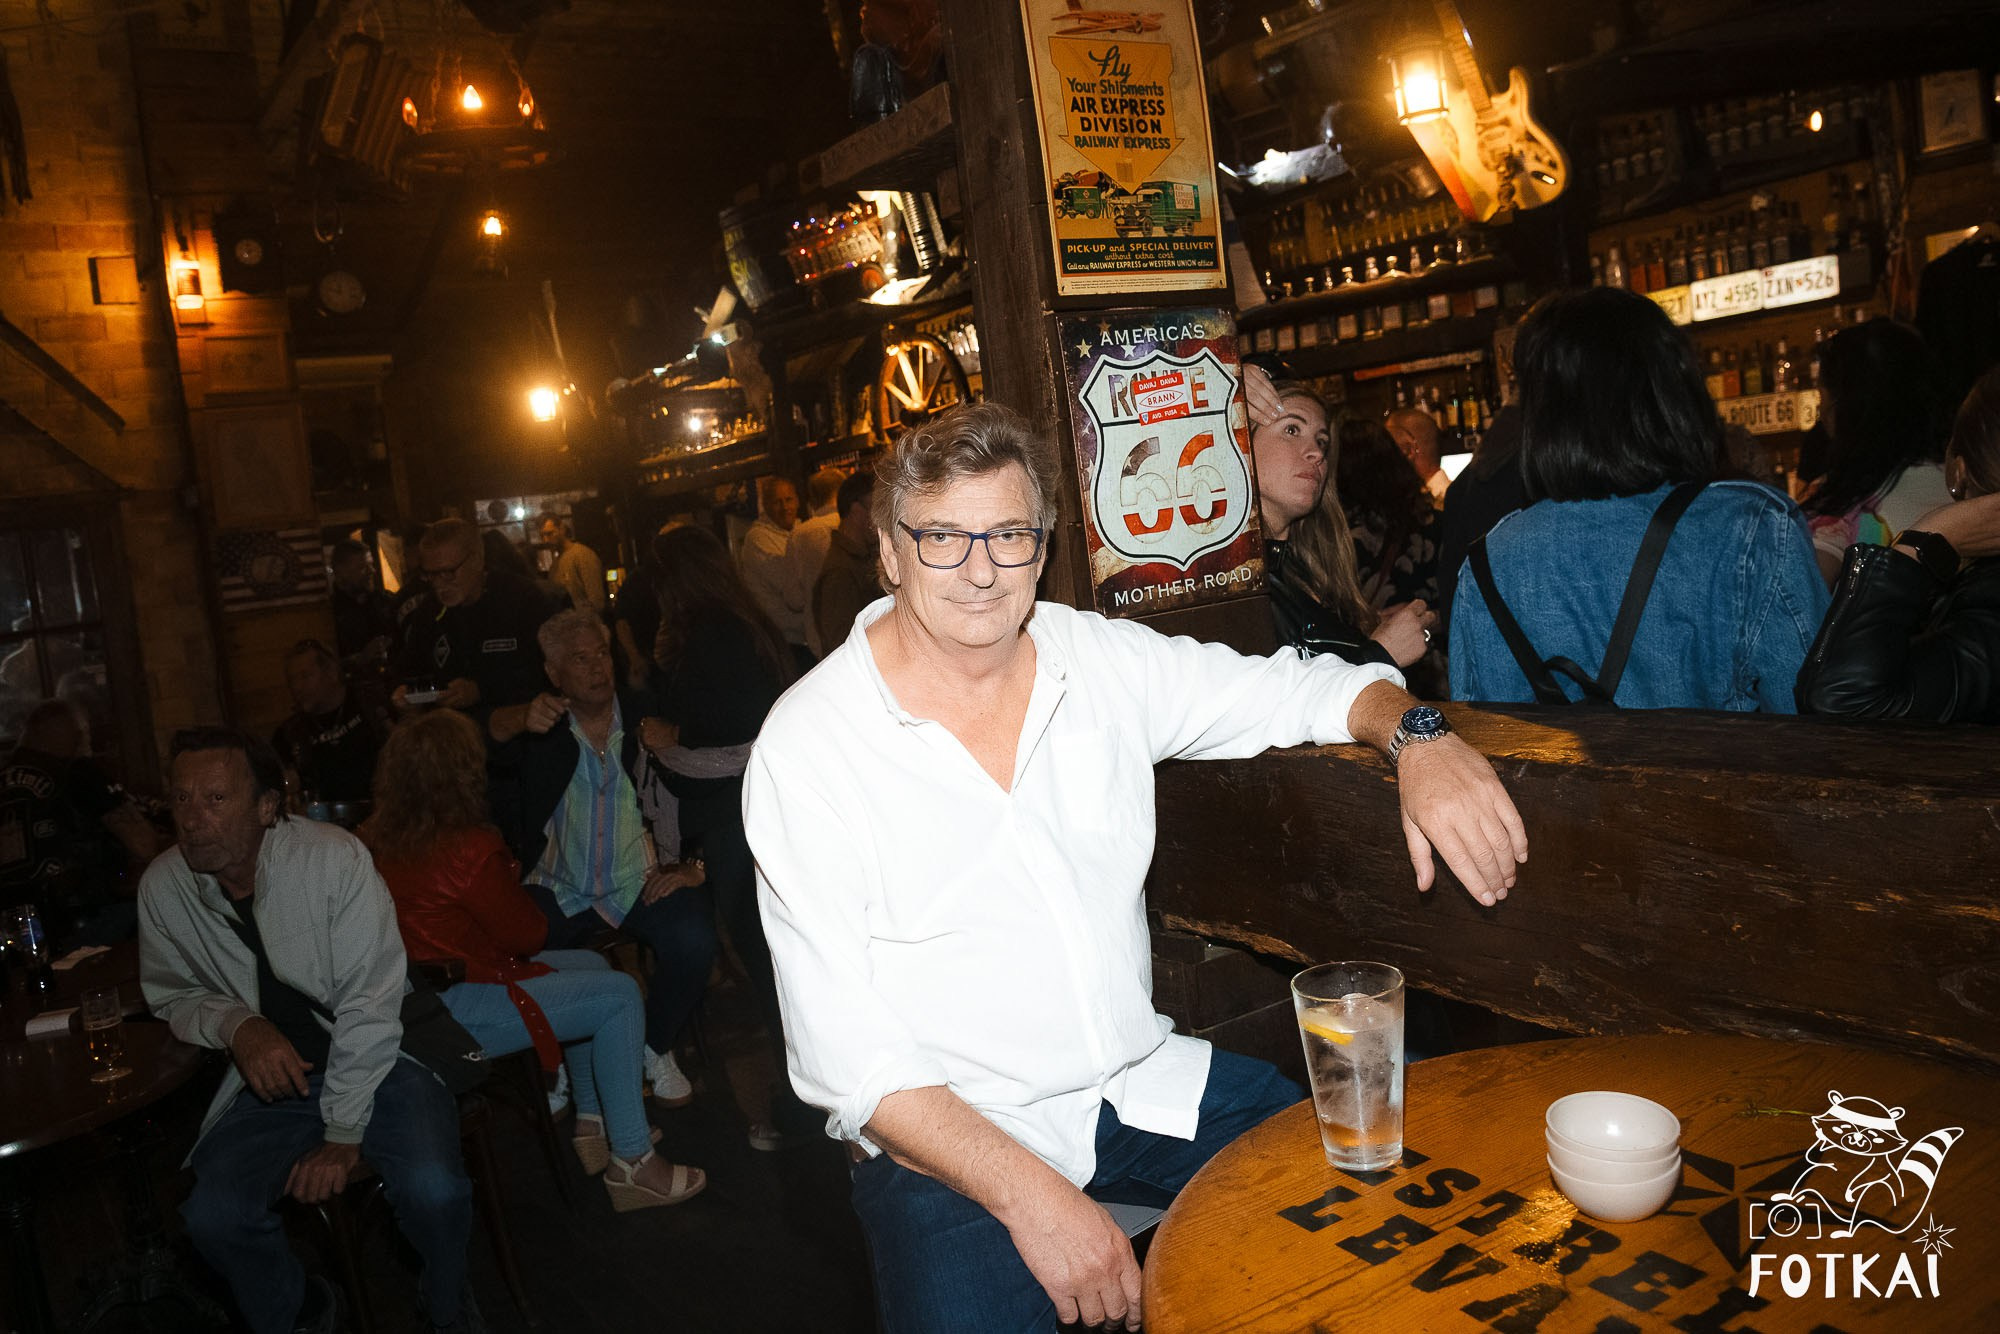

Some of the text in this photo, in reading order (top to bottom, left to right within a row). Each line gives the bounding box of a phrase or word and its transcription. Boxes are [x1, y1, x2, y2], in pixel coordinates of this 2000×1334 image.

[1088, 45, 1132, 83] Fly
[1066, 77, 1164, 97] Your Shipments
[1071, 96, 1165, 117] AIR EXPRESS
[1080, 117, 1162, 134] DIVISION
[1074, 135, 1171, 150] RAILWAY EXPRESS
[1067, 241, 1214, 254] PICK-UP and SPECIAL DELIVERY
[1089, 262, 1116, 270] RAILWAY
[1116, 261, 1142, 269] EXPRESS
[1148, 260, 1176, 268] WESTERN
[1176, 259, 1197, 267] UNION
[1100, 324, 1206, 347] AMERICA'S
[1138, 376, 1178, 391] DAVAJ DAVAJ
[1147, 392, 1176, 406] BRANN
[1120, 429, 1228, 544] 66
[1114, 566, 1252, 607] MOTHER ROAD
